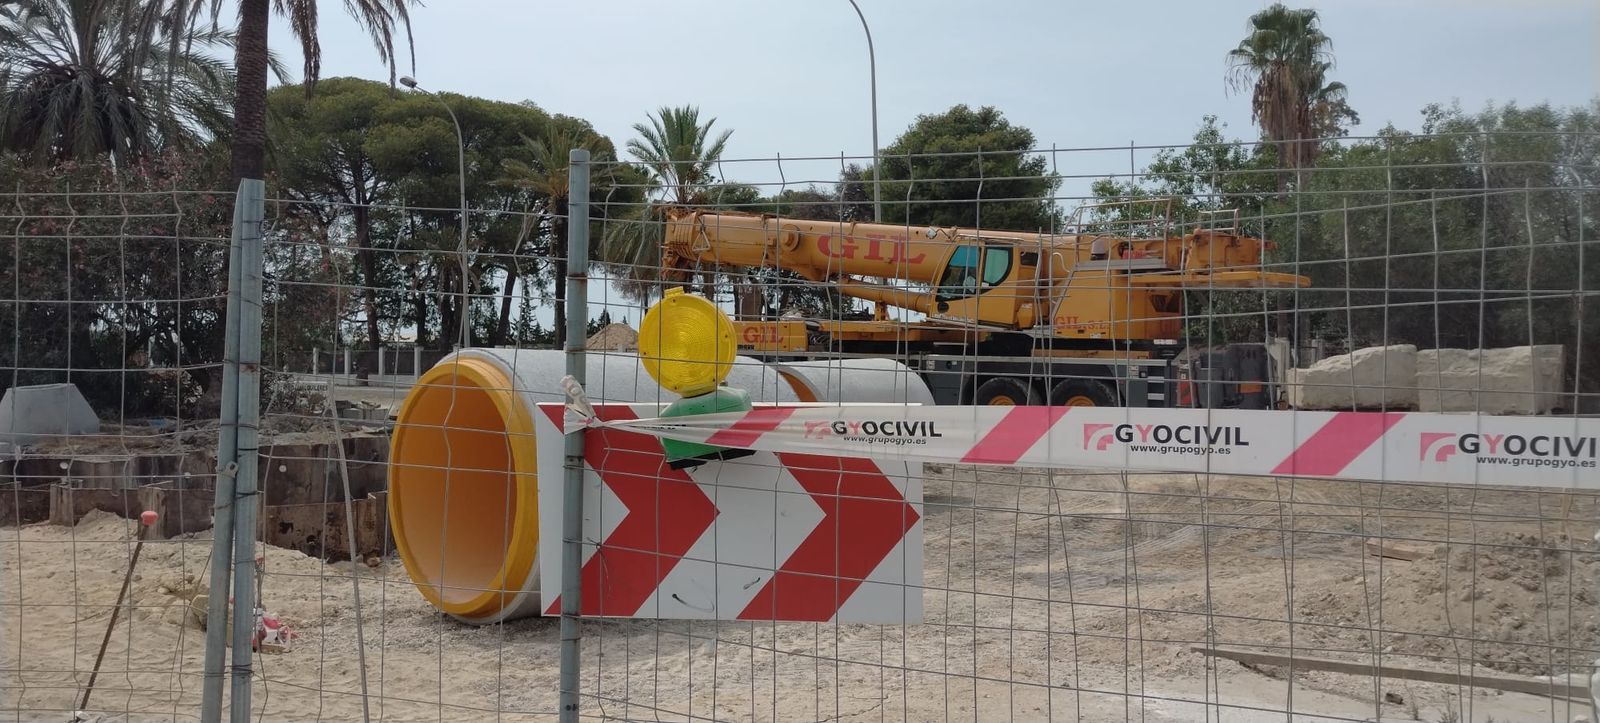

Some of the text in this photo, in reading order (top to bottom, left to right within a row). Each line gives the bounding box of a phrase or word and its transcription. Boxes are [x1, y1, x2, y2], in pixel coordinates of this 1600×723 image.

[817, 232, 926, 264] GIL
[743, 326, 784, 343] GIL
[832, 421, 942, 437] GYOCIVIL
[1115, 424, 1249, 446] GYOCIVIL
[843, 435, 927, 446] www.grupogyo.es
[1458, 433, 1597, 458] GYOCIVI
[1130, 444, 1231, 455] www.grupogyo.es
[1476, 456, 1596, 469] www.grupogyo.es
